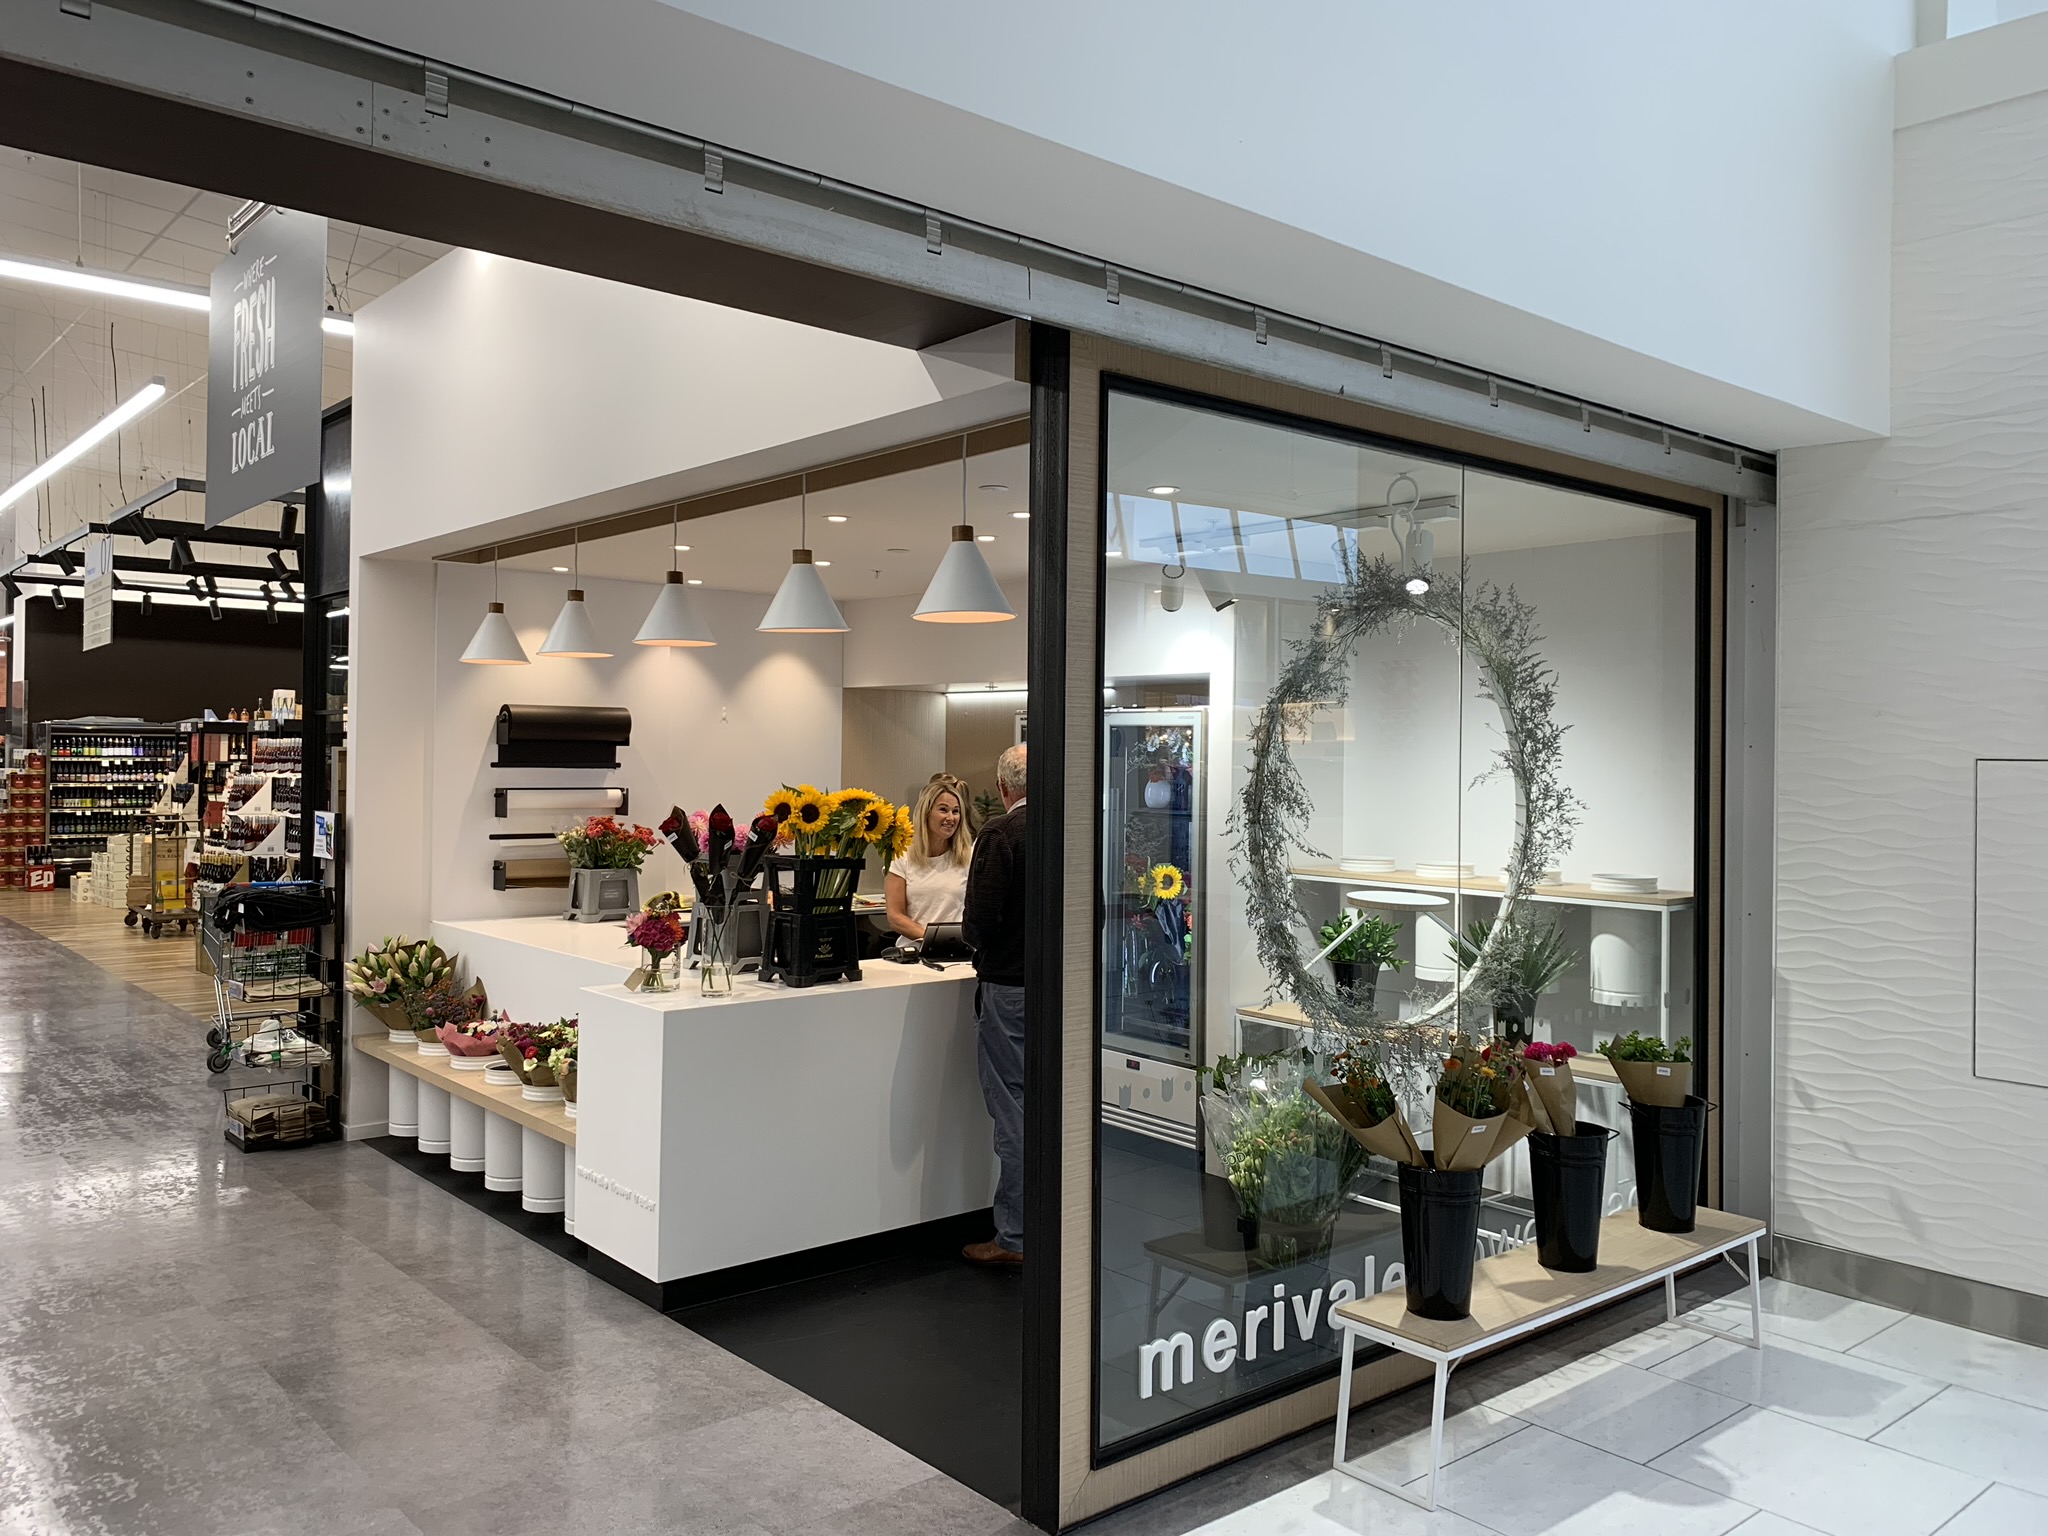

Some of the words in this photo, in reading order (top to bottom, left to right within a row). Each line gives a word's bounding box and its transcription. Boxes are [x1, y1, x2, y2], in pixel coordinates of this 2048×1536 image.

[243, 256, 264, 290] WHERE
[233, 276, 275, 393] FRESH
[241, 384, 261, 419] MEETS
[232, 411, 275, 474] LOCAL
